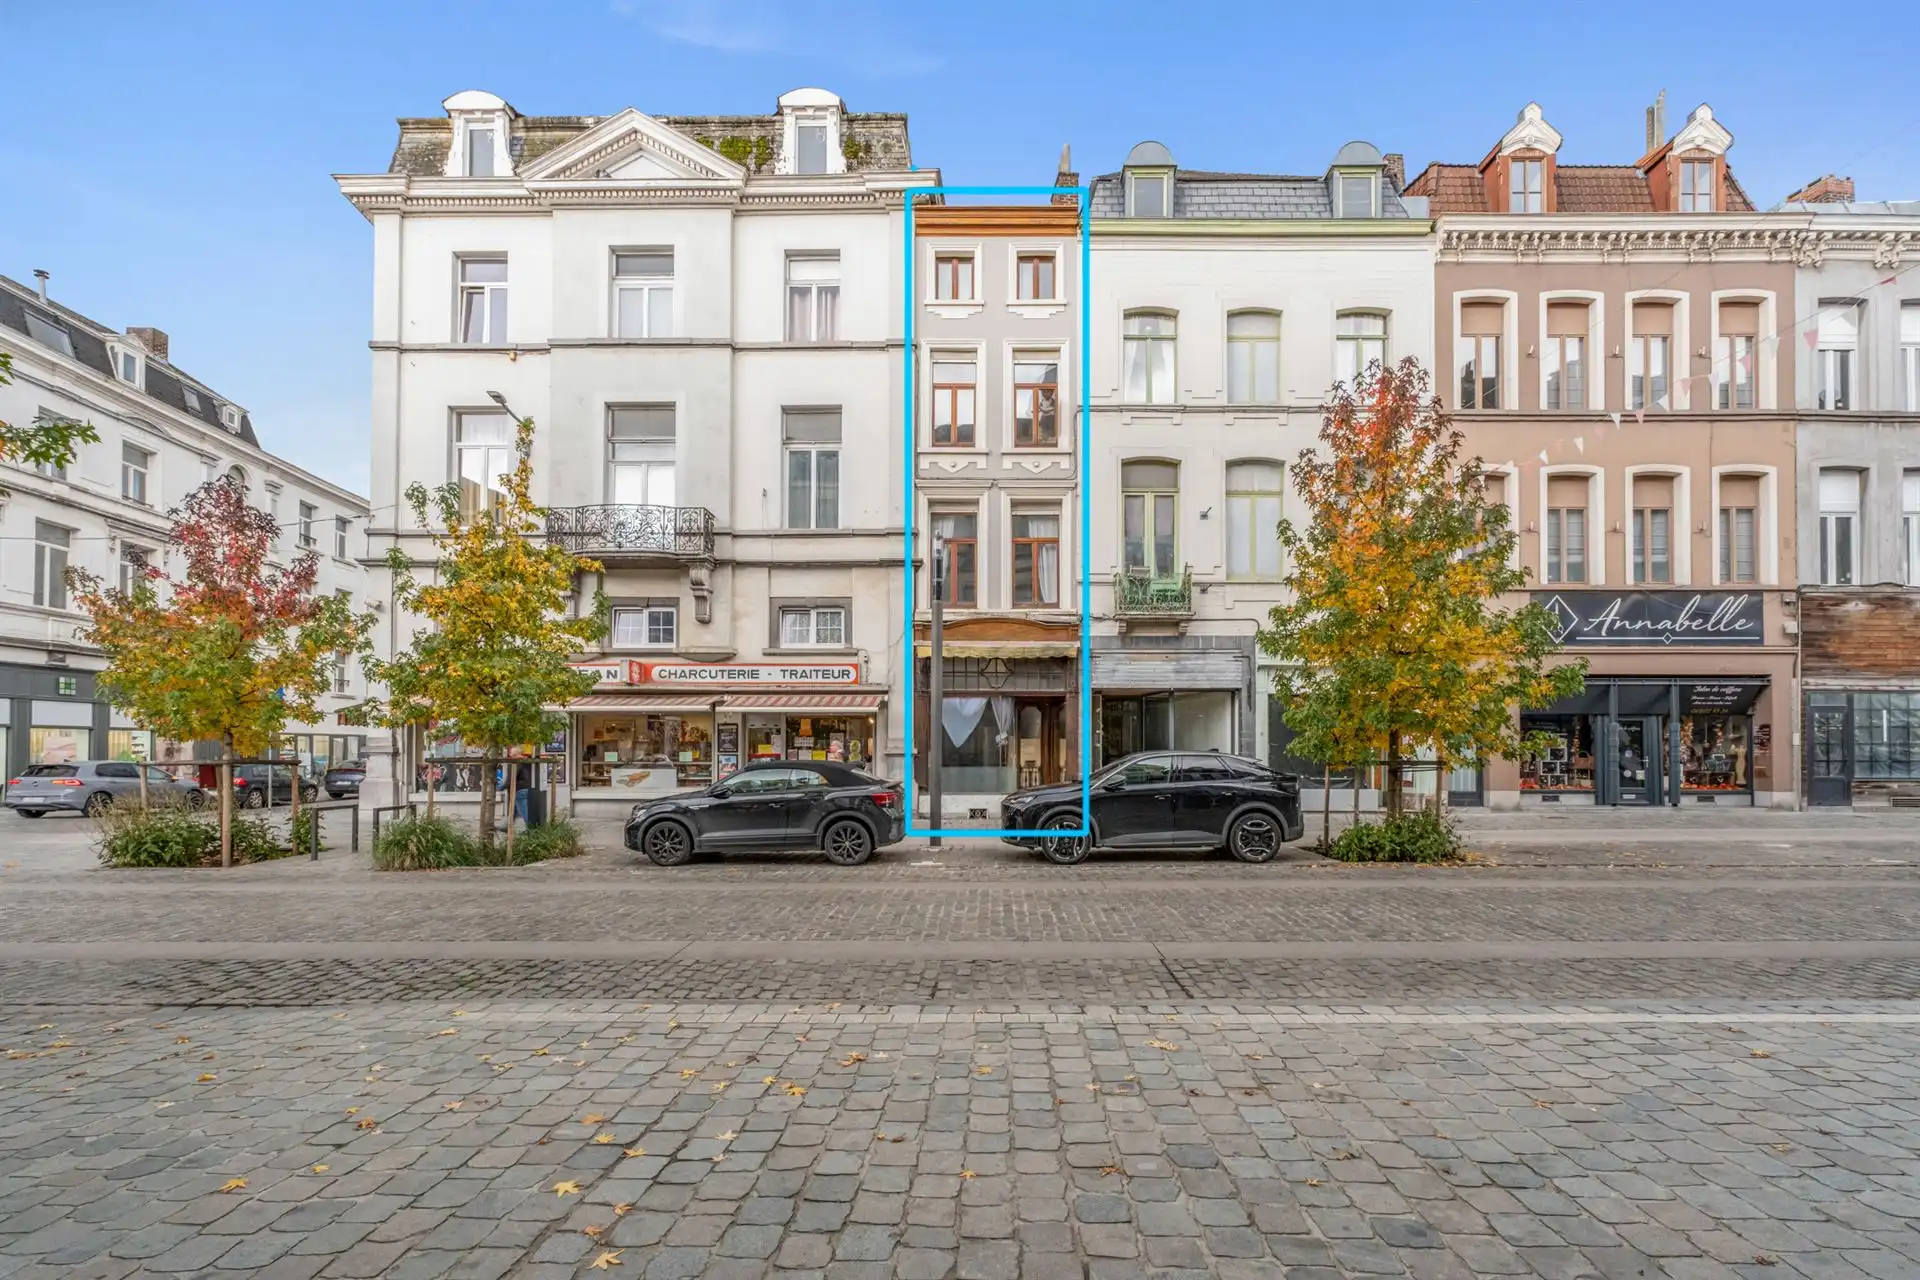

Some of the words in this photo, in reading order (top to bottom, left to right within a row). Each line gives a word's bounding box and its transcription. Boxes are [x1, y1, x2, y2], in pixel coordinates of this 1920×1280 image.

[1583, 593, 1754, 637] Annabelle
[658, 669, 760, 679] CHARCUTERIE
[780, 669, 851, 679] TRAITEUR
